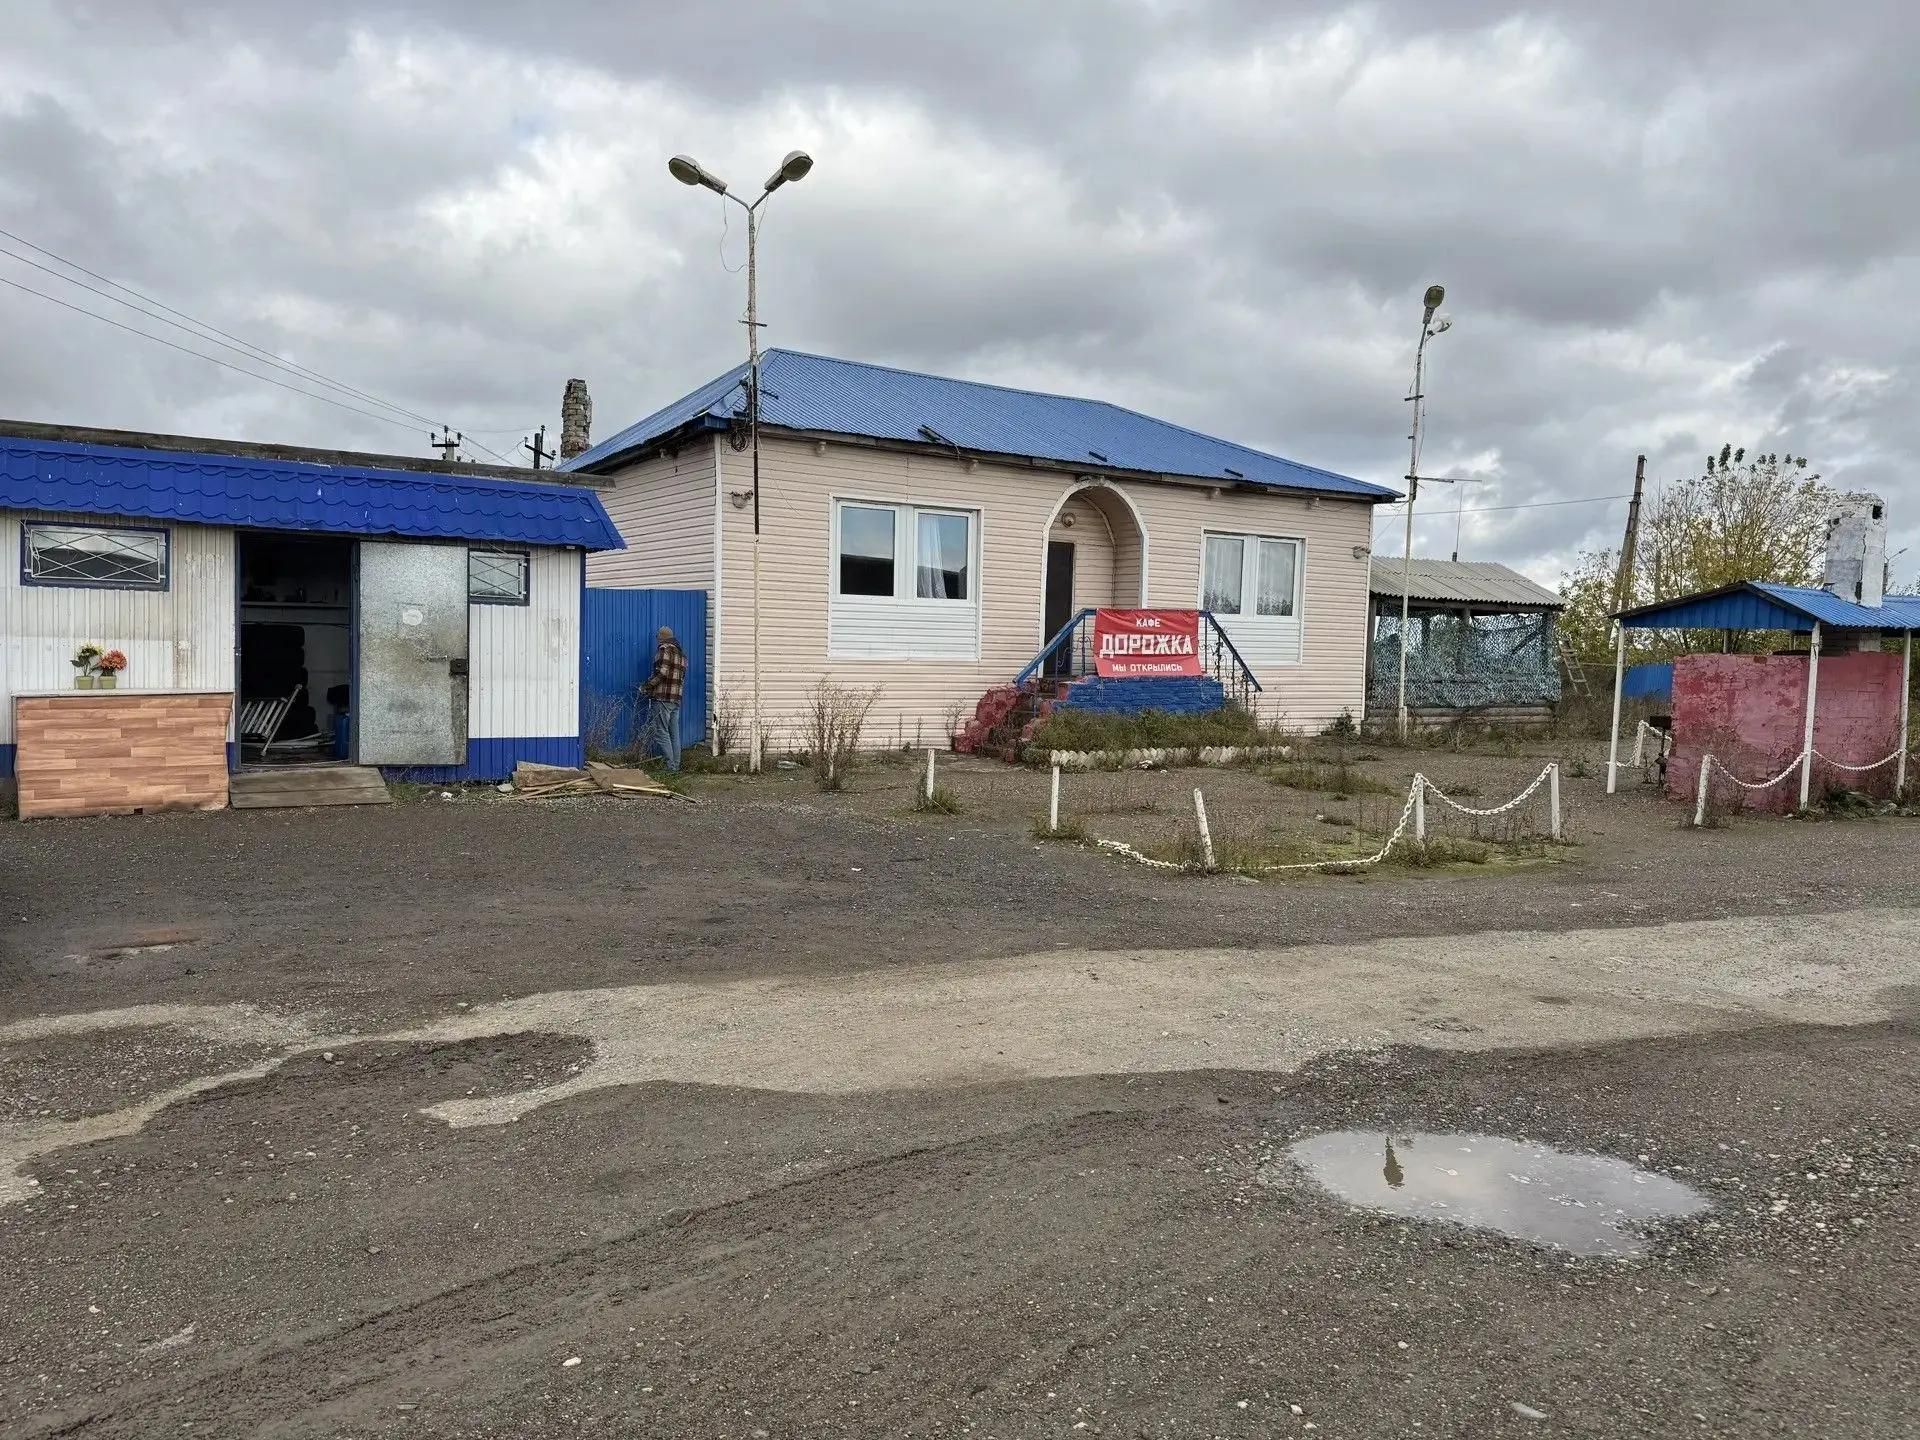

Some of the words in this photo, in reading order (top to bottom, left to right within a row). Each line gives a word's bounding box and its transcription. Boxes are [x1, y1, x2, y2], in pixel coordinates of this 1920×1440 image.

[1136, 618, 1161, 628] КАФЕ
[1099, 633, 1193, 658] ДОРОЖКА
[1112, 663, 1127, 672] МЫ
[1130, 663, 1183, 672] ОТКРЫЛИСЬ
